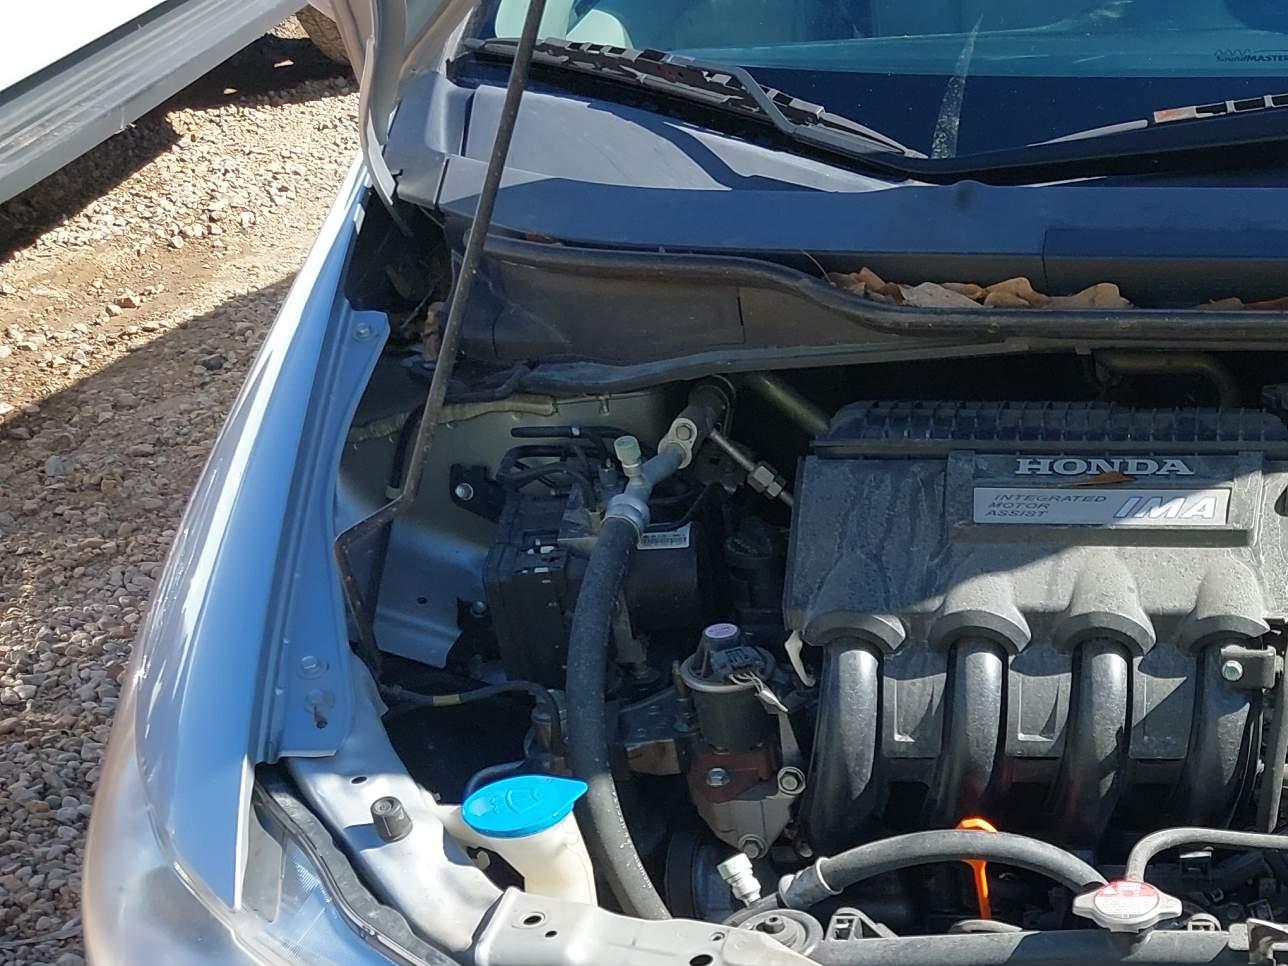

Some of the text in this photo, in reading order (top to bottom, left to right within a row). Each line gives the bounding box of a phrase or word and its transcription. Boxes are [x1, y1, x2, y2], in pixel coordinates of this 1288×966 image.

[1015, 458, 1195, 476] HONDA
[994, 494, 1108, 503] INTEGRATED
[987, 502, 1052, 510] MOTOR
[1113, 496, 1219, 520] IMA
[985, 509, 1049, 518] ASSIST
